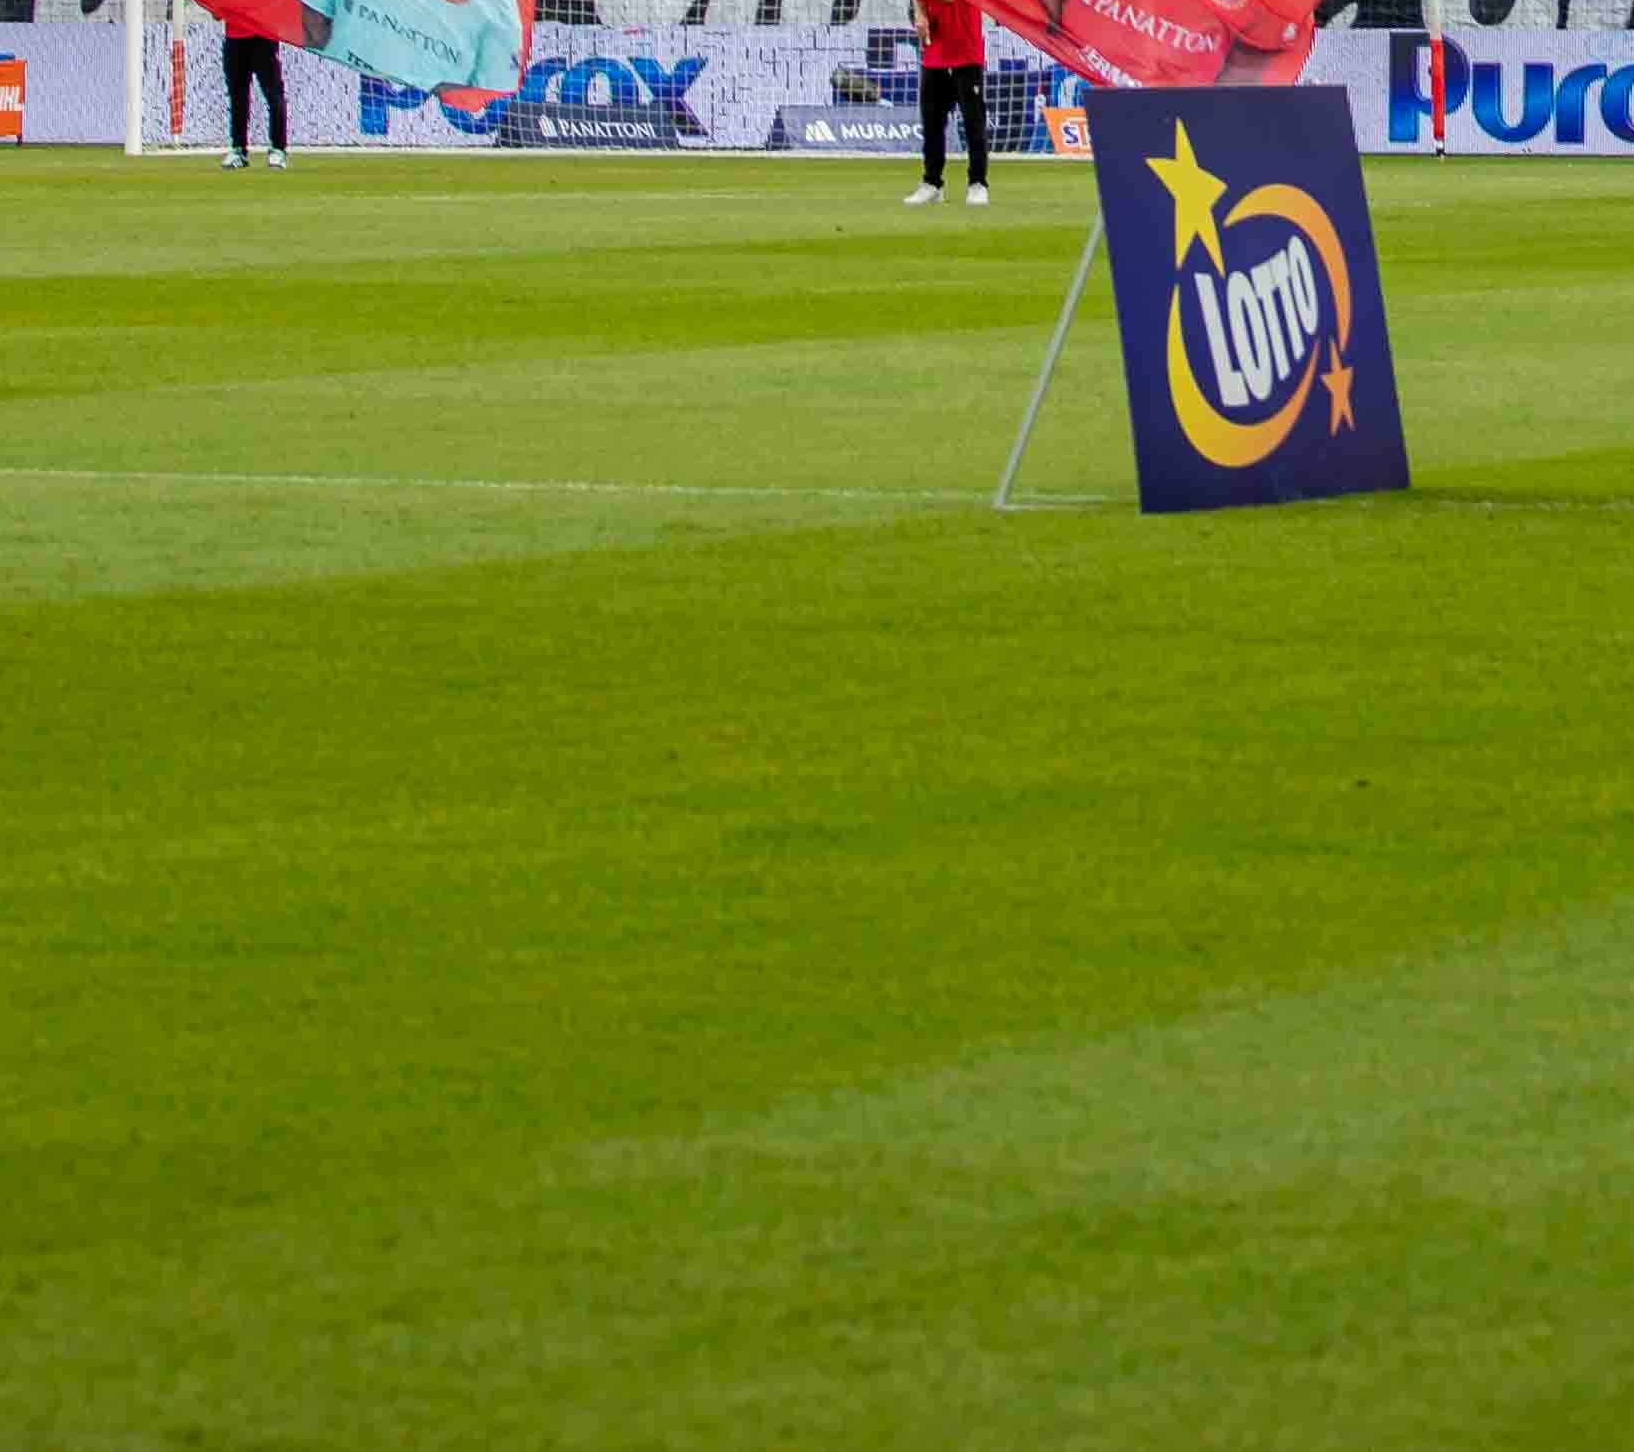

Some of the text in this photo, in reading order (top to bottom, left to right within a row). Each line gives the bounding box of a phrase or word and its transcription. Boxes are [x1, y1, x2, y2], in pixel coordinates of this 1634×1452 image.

[559, 118, 657, 138] PANATTONI
[840, 123, 925, 141] MURAPO
[1194, 235, 1319, 408] LOTTO
